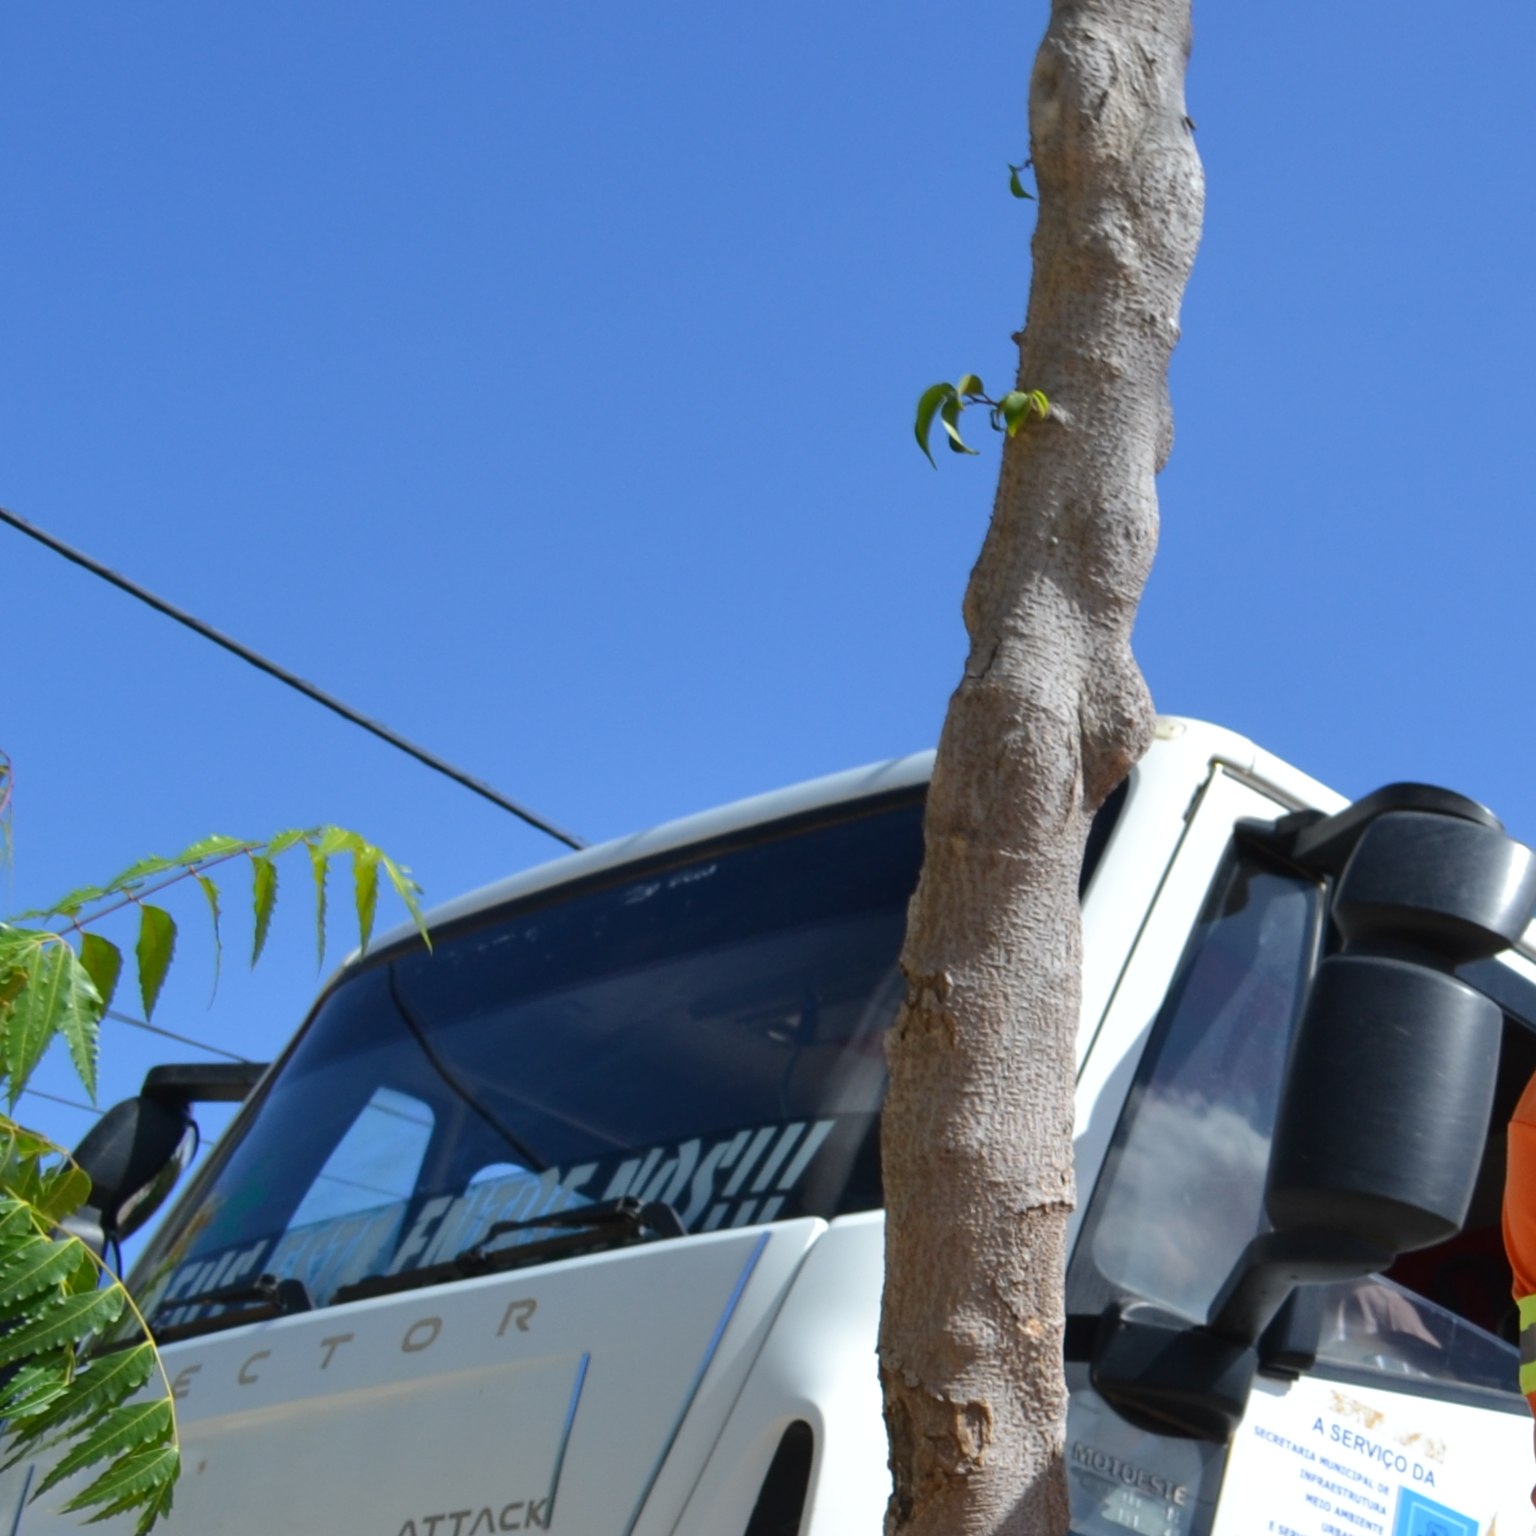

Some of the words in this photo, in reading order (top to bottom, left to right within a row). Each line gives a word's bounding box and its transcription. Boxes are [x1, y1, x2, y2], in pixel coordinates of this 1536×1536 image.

[172, 1297, 538, 1399] ECTOR
[1072, 1441, 1188, 1506] MOTOESTE
[1254, 1426, 1316, 1462] SECRETARIA
[1319, 1456, 1374, 1490] MUNICIPAL
[1377, 1483, 1390, 1496] DE
[1312, 1417, 1324, 1435] A
[1329, 1424, 1408, 1472] SERVIÇO
[1412, 1462, 1436, 1488] DA
[1300, 1468, 1387, 1516] INFRAESTRUTURA
[1305, 1493, 1332, 1512] MEIO
[1334, 1507, 1384, 1536] AMBIENTE
[1268, 1520, 1275, 1532] E
